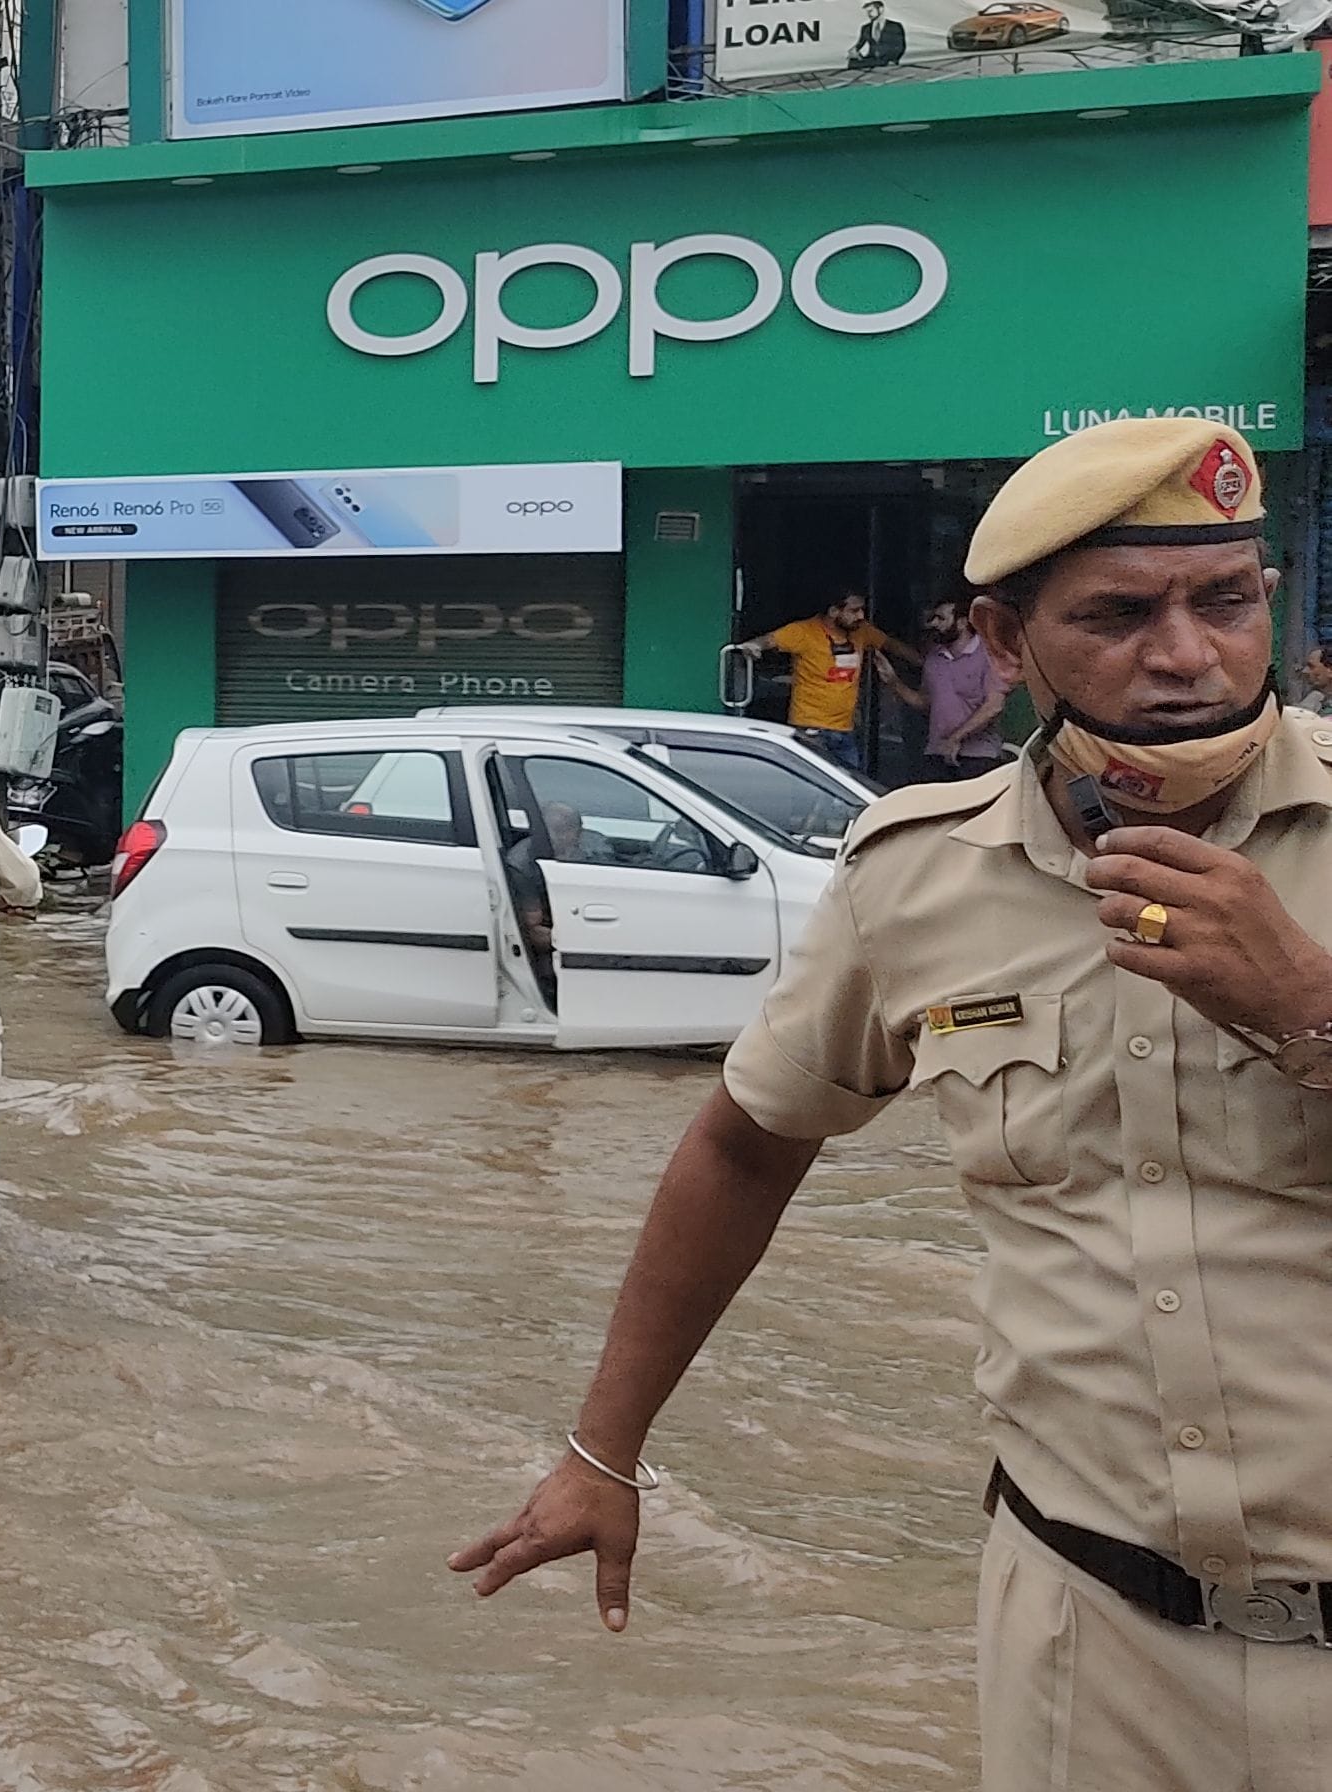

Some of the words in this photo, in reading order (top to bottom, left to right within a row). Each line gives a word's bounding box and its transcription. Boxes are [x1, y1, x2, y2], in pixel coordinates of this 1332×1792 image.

[723, 20, 821, 49] LOAN
[327, 224, 948, 384] oppo
[50, 502, 100, 518] Reno6
[113, 501, 164, 516] Reno6
[170, 500, 195, 515] Pro
[506, 500, 574, 517] oppo
[64, 527, 85, 536] NEW
[86, 525, 124, 535] ARRIVAL
[284, 668, 418, 694] Camera
[438, 671, 556, 697] Phone
